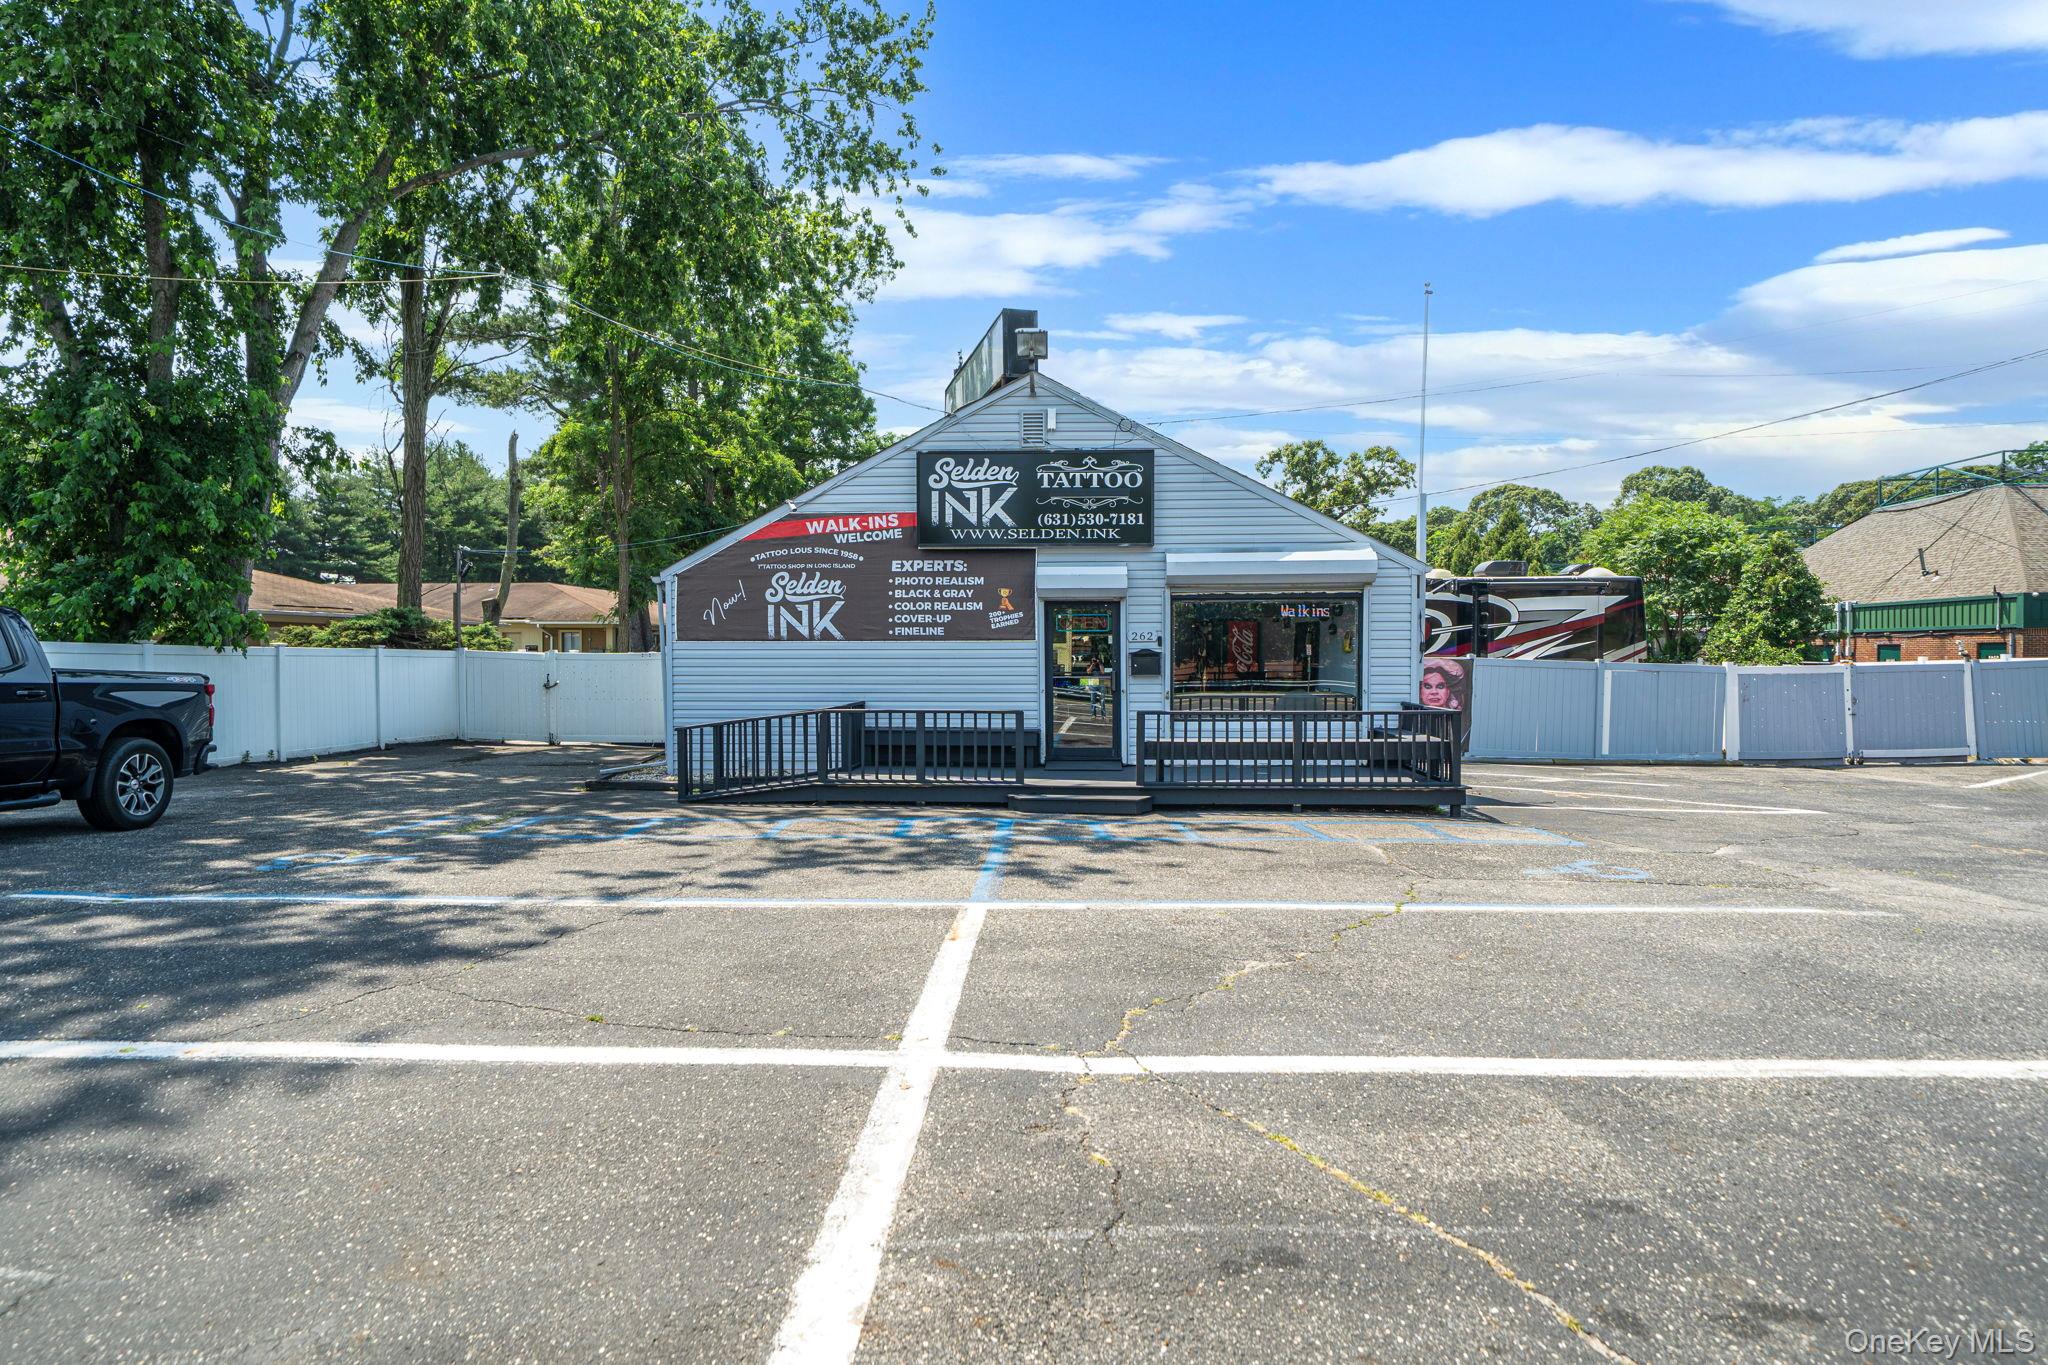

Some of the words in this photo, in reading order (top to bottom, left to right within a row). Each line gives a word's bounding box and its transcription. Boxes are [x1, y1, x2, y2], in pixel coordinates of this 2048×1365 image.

[928, 457, 1019, 489] Selden
[1037, 472, 1143, 488] TATTOO
[931, 487, 1019, 527] INK
[805, 513, 899, 534] WALK-INS
[833, 528, 903, 544] WELCOME
[951, 528, 1121, 540] WWW.SELDEN.INK
[755, 548, 788, 560] TATTOO
[790, 547, 812, 555] LOUS
[814, 547, 839, 556] SINCE
[840, 550, 859, 560] 1958
[891, 560, 968, 572] EXPERTS:
[765, 571, 847, 603] Selden
[895, 576, 933, 585] PHOTO
[936, 576, 984, 585] REALISM
[895, 589, 931, 598] BLACK
[933, 589, 941, 598] &
[943, 589, 974, 598] GRAY
[703, 579, 747, 626] Now!
[894, 602, 932, 611] COLOR
[934, 602, 983, 611] REALISM
[767, 600, 846, 640] INK
[894, 614, 952, 623] COVER-UP
[989, 611, 1024, 624] TROPHIES
[991, 618, 1020, 629] EARNED
[895, 627, 945, 636] FINELINE
[1131, 631, 1153, 641] 262
